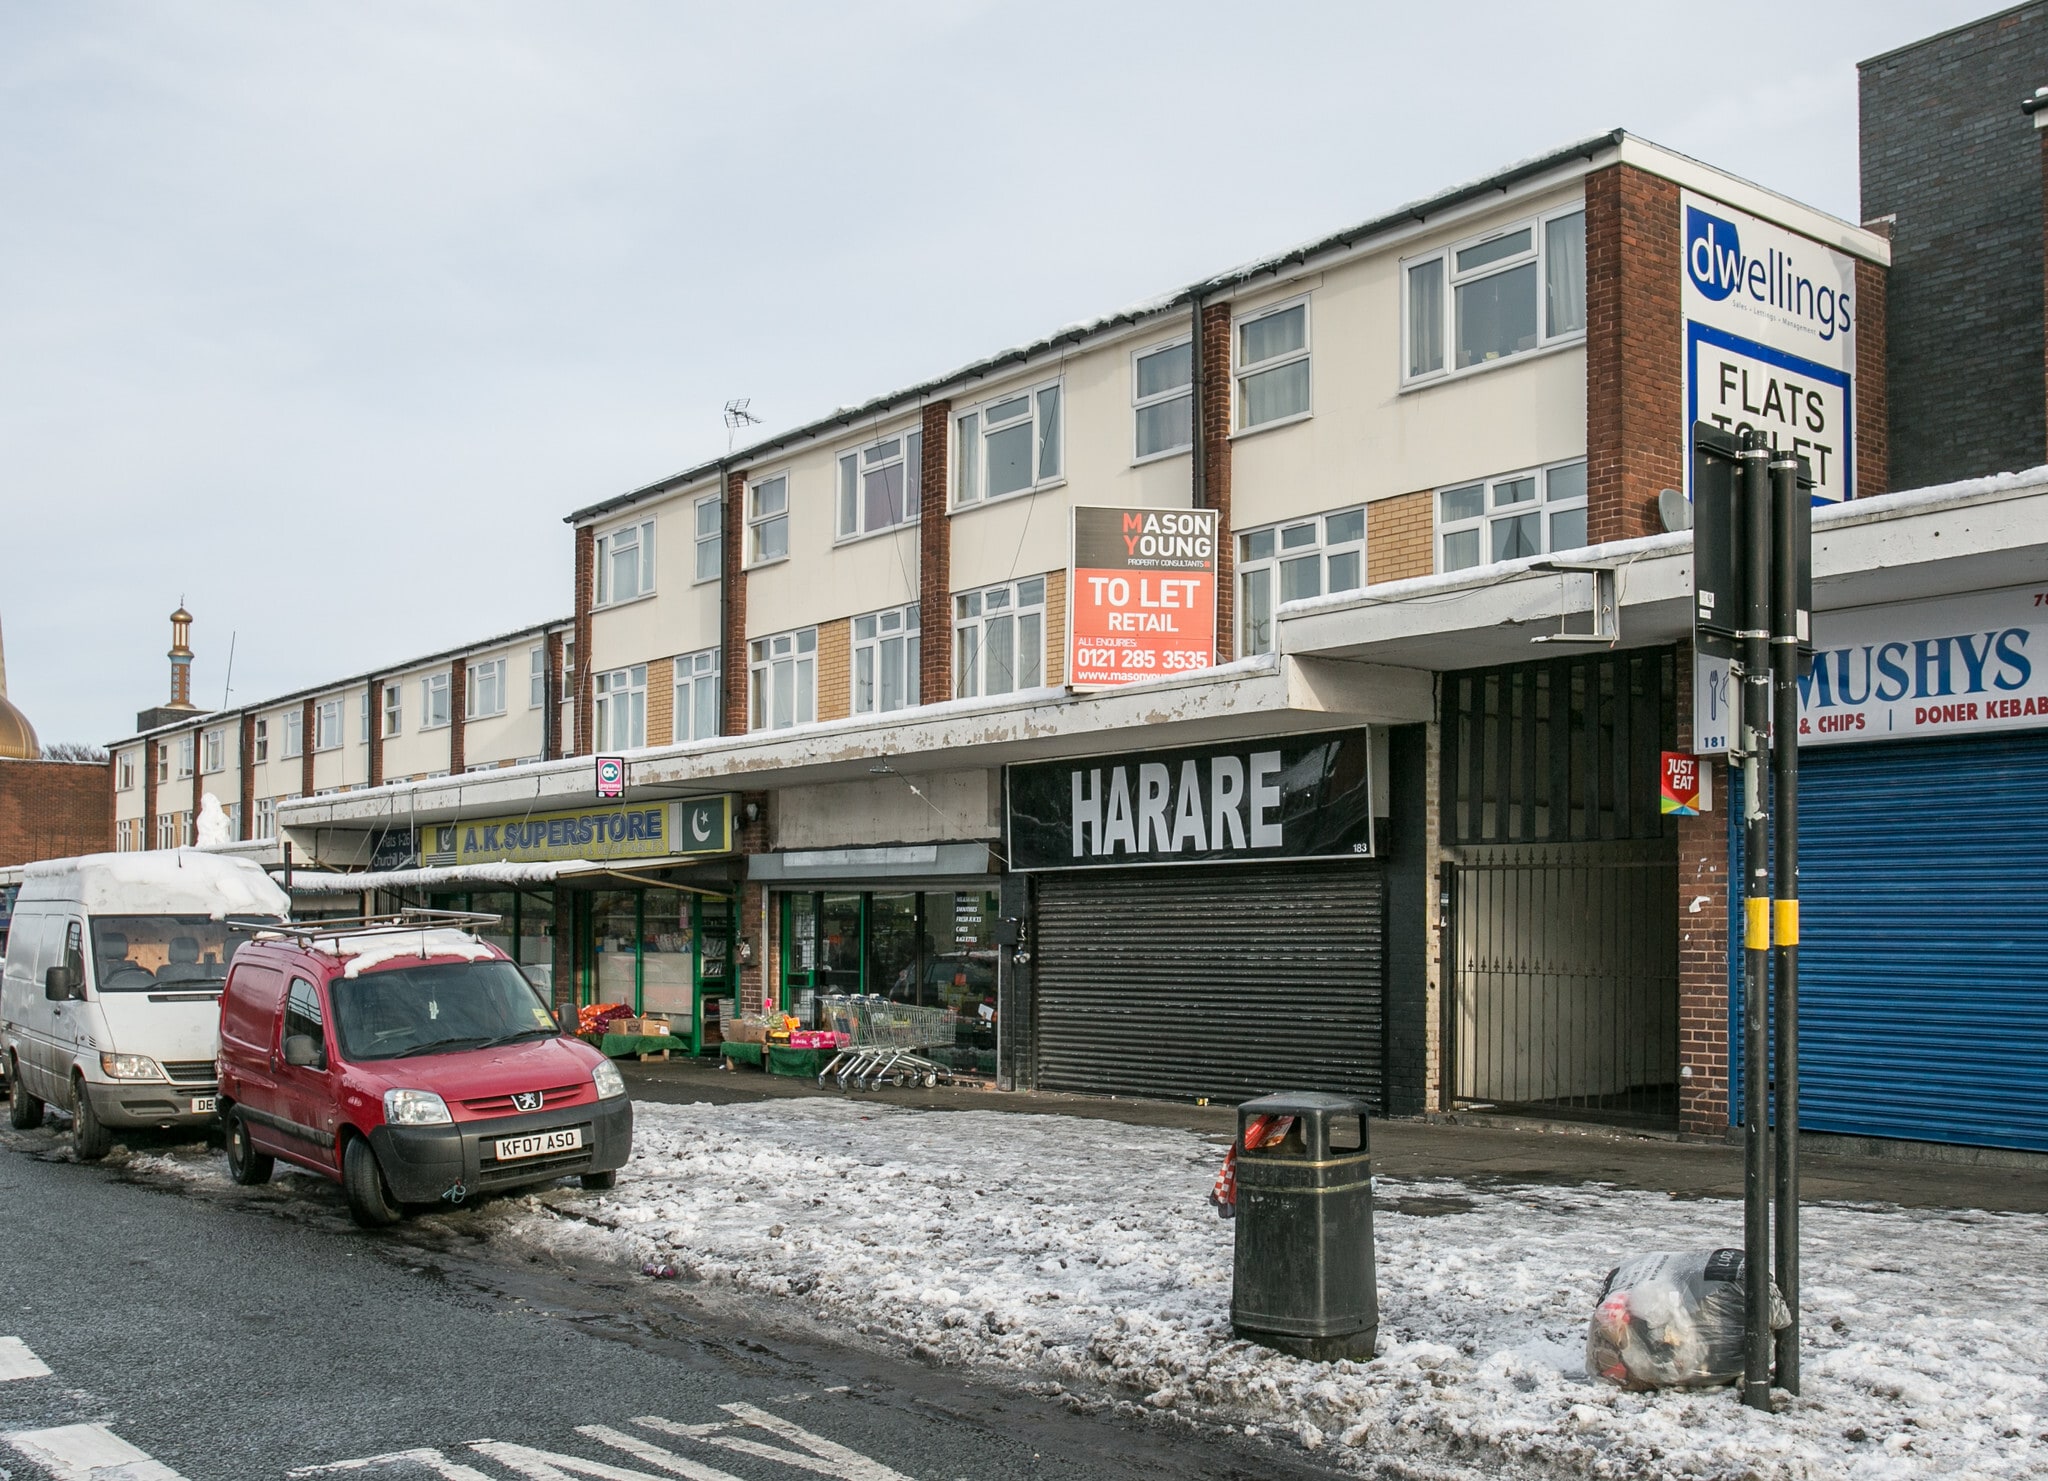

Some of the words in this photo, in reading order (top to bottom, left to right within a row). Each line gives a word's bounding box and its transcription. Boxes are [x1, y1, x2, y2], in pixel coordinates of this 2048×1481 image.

[1691, 223, 1852, 341] dwellings
[1732, 299, 1748, 312] Sales
[1753, 307, 1777, 322] Lettings
[1782, 318, 1817, 336] Management
[1719, 361, 1825, 433] FLATS
[1122, 512, 1212, 536] MASON
[1123, 534, 1212, 558] YOUNG
[1127, 558, 1160, 567] PROPERTY
[1160, 559, 1205, 568] CONSULTANTS
[1088, 577, 1130, 607] TO
[1140, 579, 1201, 609] LET
[1108, 612, 1180, 633] RETAIL
[1078, 638, 1093, 647] ALL
[1077, 648, 1115, 668] 0121
[1121, 649, 1156, 669] 285
[1162, 651, 1208, 670] 3535
[1797, 628, 2032, 711] MUSHYS
[1799, 717, 1812, 735] &
[1818, 712, 1866, 734] CHIPS
[1915, 702, 1979, 725] DONER
[1703, 735, 1726, 749] 181
[1667, 758, 1695, 776] JUST
[1672, 773, 1695, 791] EAT
[1071, 750, 1283, 858] HARARE
[597, 839, 665, 856] VEGETABLES
[1353, 842, 1368, 853] 183
[502, 1137, 542, 1156] KF07
[547, 1132, 575, 1149] ASO
